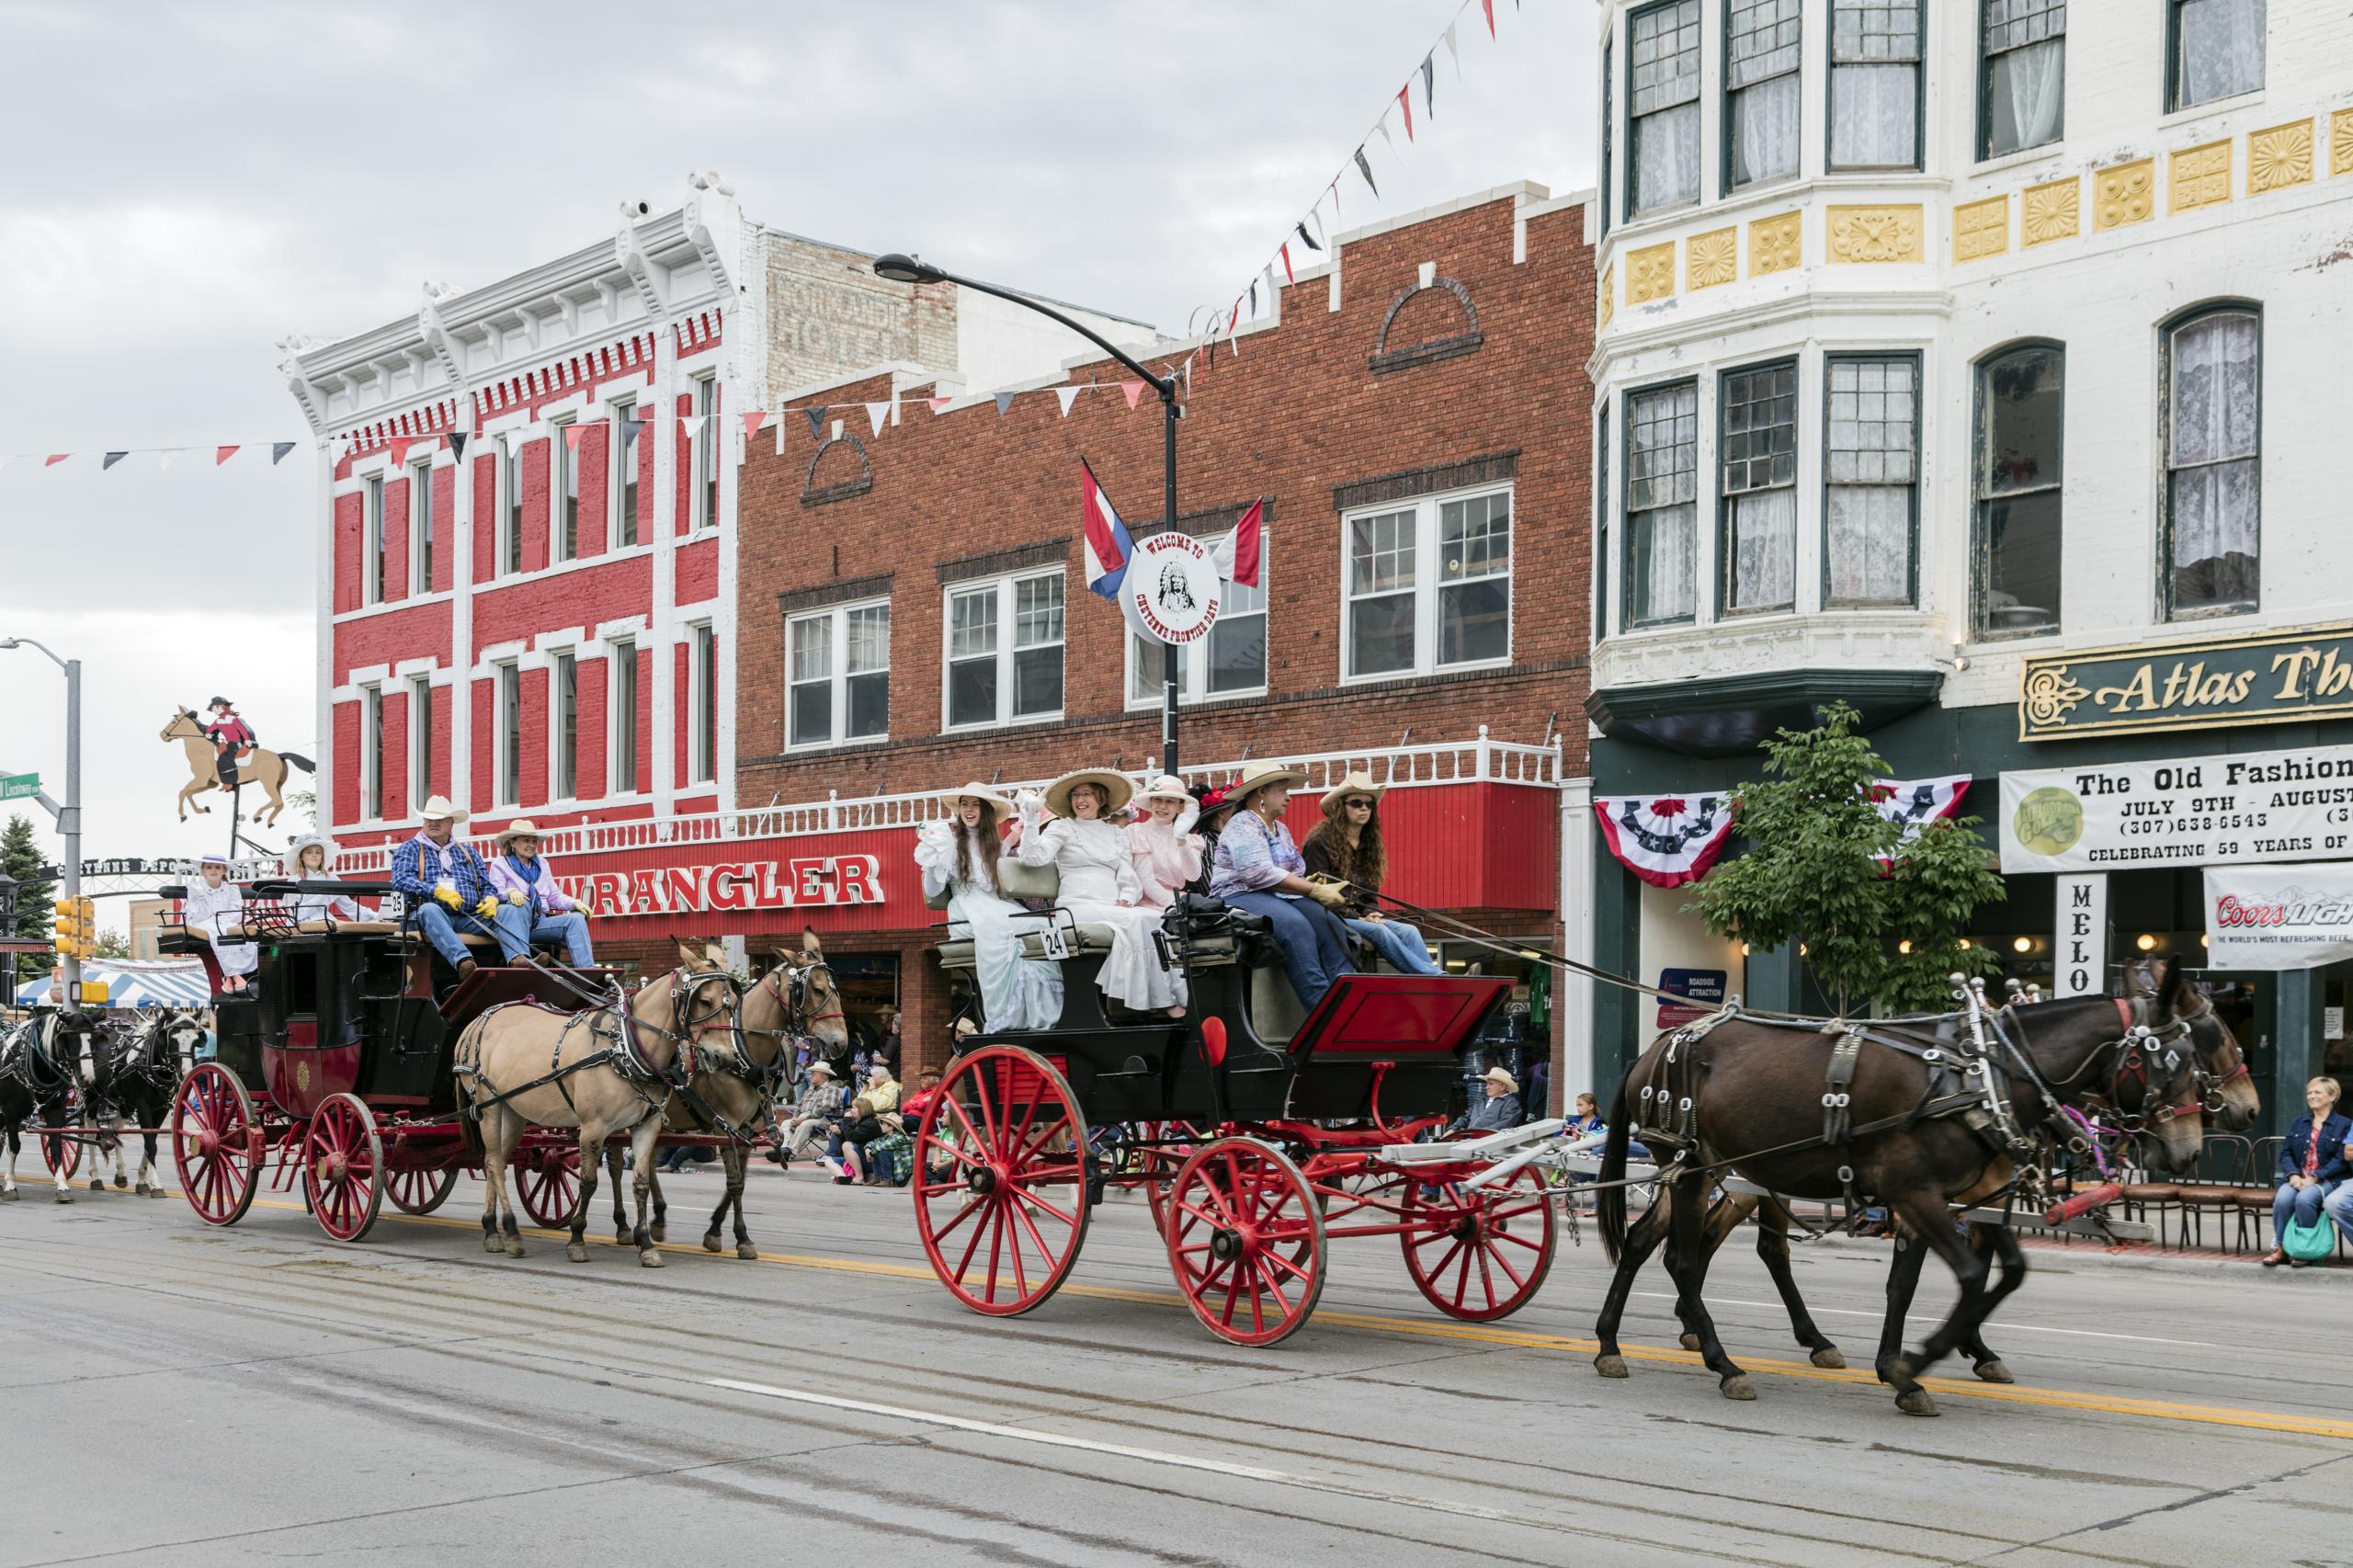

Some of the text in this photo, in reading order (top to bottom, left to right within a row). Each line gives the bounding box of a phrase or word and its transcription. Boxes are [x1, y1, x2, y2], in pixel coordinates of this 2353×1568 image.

[1146, 535, 1204, 560] WELCOME TO
[1136, 594, 1219, 643] CHEYENNE FRONTIER DAYS
[2095, 646, 2353, 713] Atlas Th
[2075, 756, 2353, 796] The Old Fashion
[2120, 800, 2175, 817] JULY
[2192, 796, 2235, 812] 9TH
[2120, 812, 2268, 837] (307)638-6543
[2088, 835, 2347, 861] CELEBRATING 59 YEARS OF
[56, 860, 183, 877] CYENNE DEPO
[392, 895, 402, 912] 25
[2217, 893, 2287, 928] Coors
[1045, 932, 1063, 955] 24
[2069, 884, 2092, 992] MELO
[2229, 935, 2257, 944] WORLD'S
[2259, 935, 2279, 944] MOST
[2279, 934, 2326, 944] REFRESHING
[1688, 977, 1715, 986] ROADSIDE
[1688, 988, 1722, 997] ATTRACTION
